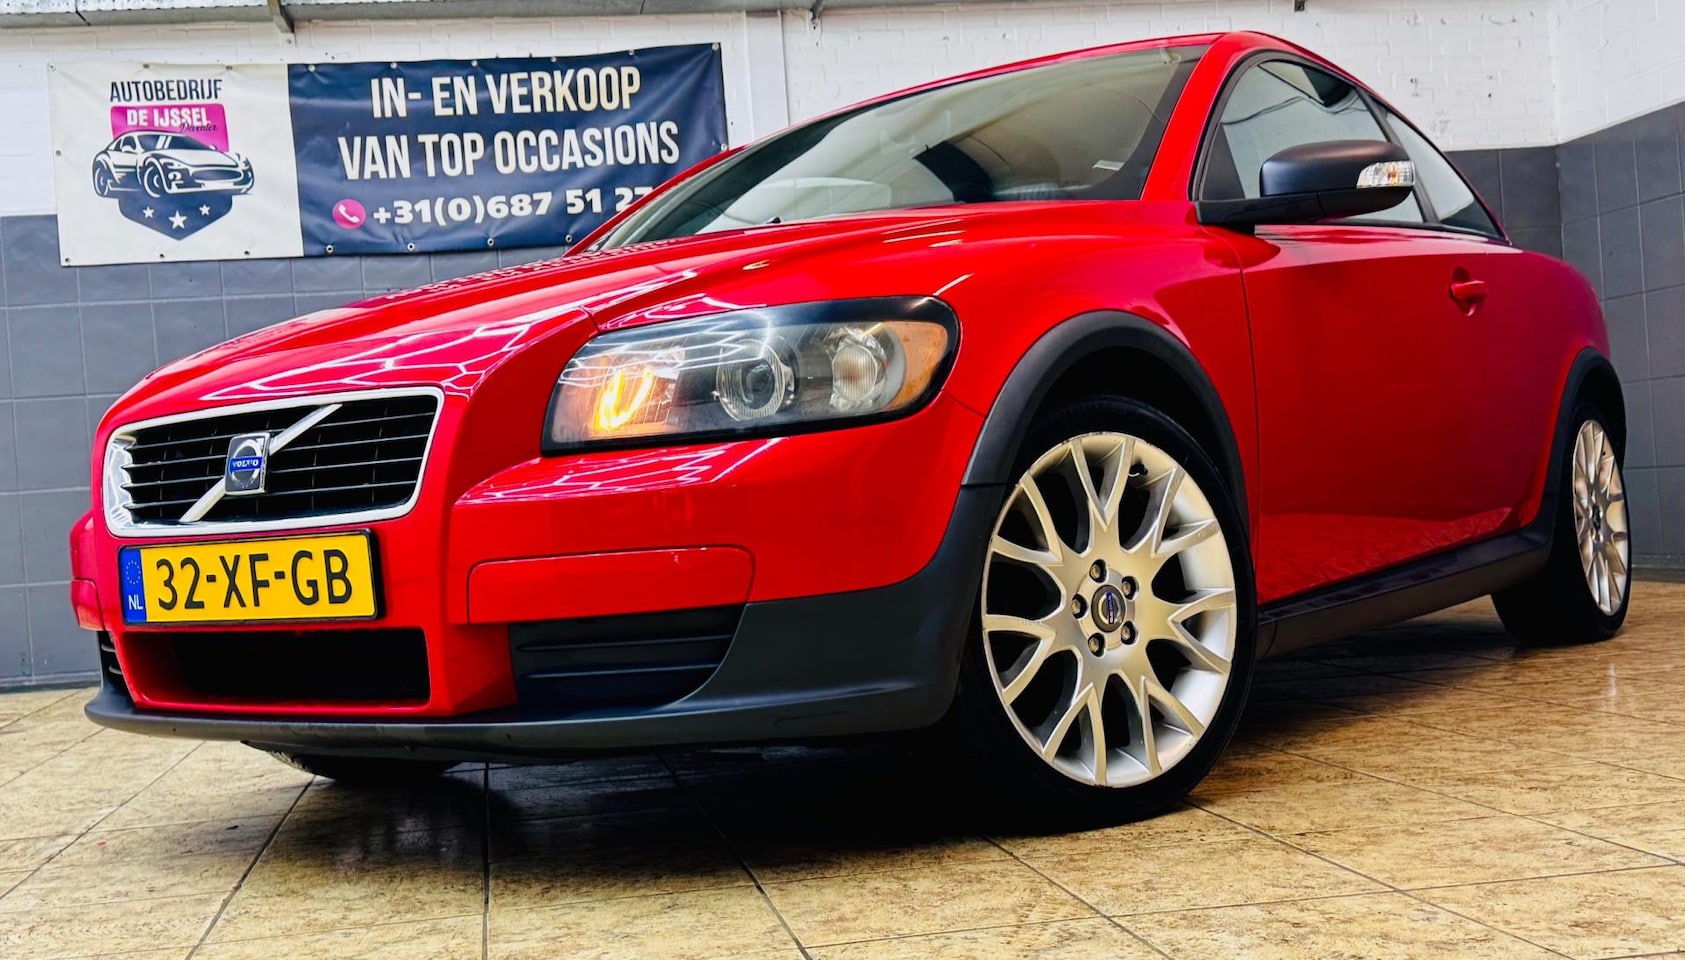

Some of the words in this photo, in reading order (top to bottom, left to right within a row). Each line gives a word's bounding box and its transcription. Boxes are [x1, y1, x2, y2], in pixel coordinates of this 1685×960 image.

[110, 79, 223, 102] AUTOBEDRIJF
[371, 77, 422, 118] IN-
[432, 75, 481, 117] EN
[485, 66, 641, 114] VERKOOP
[126, 109, 148, 126] DE
[153, 107, 210, 127] IJSSEL
[338, 134, 410, 180] VAN
[418, 132, 485, 179] TOP
[494, 120, 680, 175] OCCASIONS
[373, 191, 553, 226] +31(0)687
[566, 187, 602, 215] 51
[232, 459, 259, 468] VOLVO
[156, 549, 352, 610] 32-XF-GB
[128, 595, 144, 611] NL
